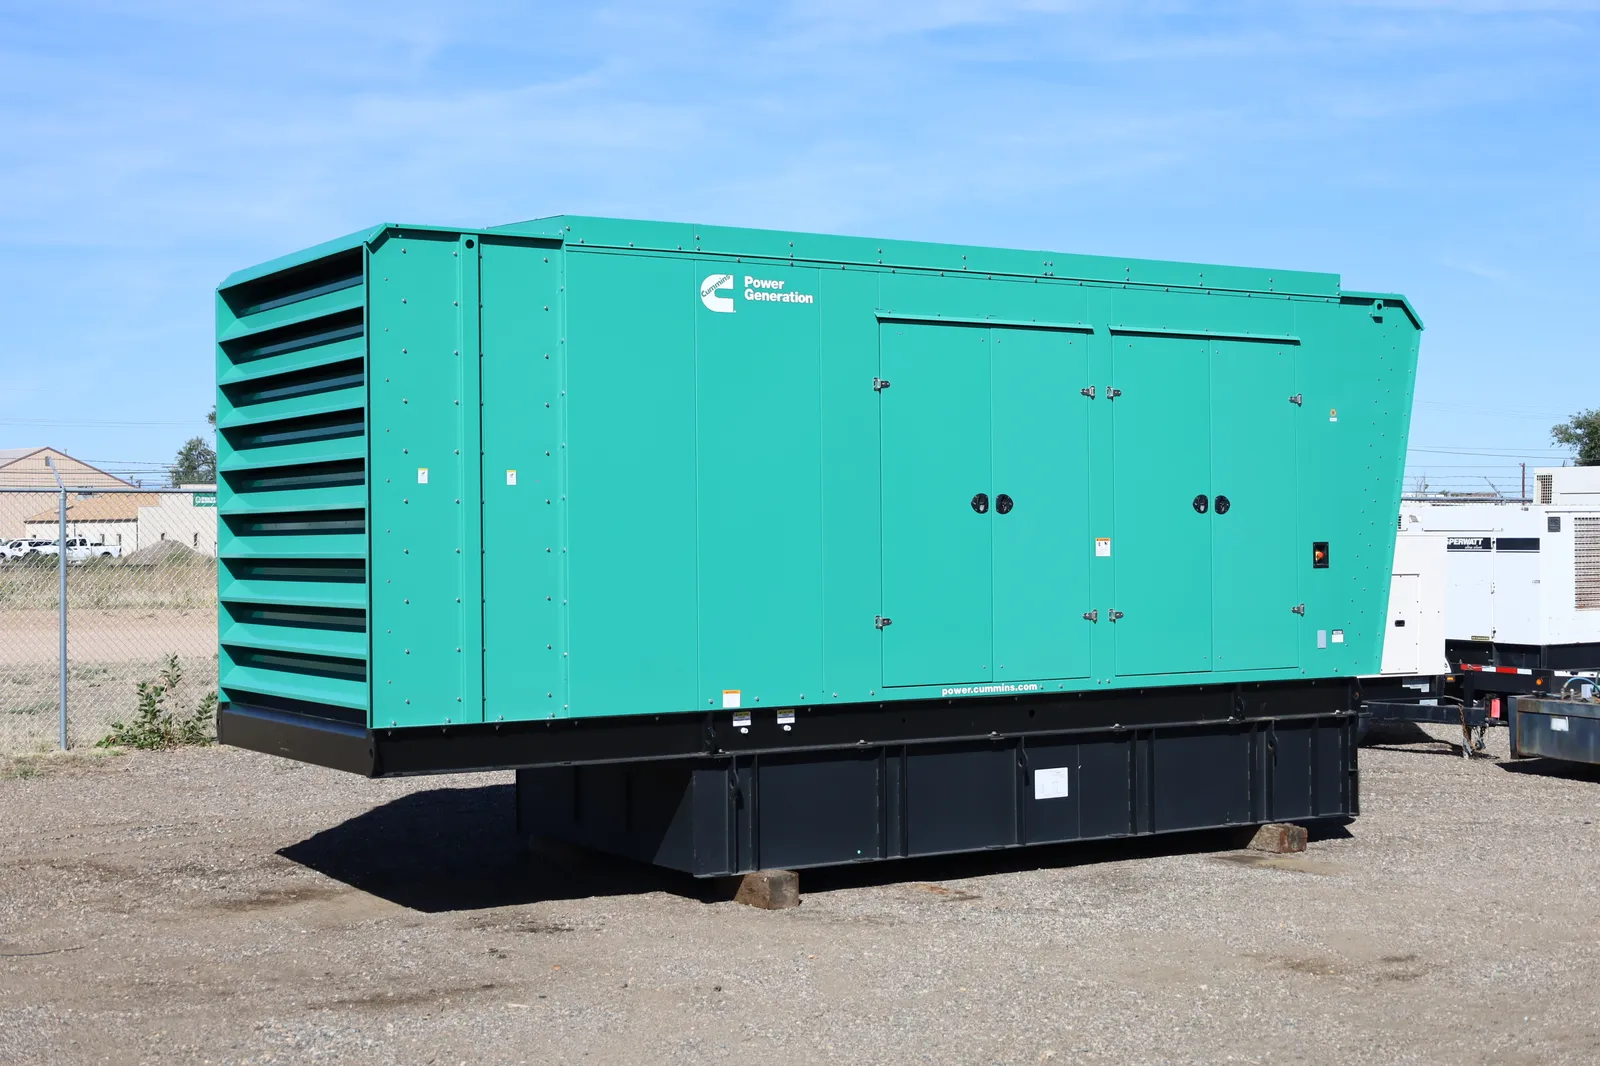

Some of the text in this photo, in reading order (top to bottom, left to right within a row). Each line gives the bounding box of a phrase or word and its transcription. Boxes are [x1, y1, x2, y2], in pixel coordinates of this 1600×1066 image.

[701, 274, 731, 298] Cummins
[744, 275, 785, 290] Power
[744, 288, 814, 304] Generation
[941, 683, 1038, 697] power.cummins.com
